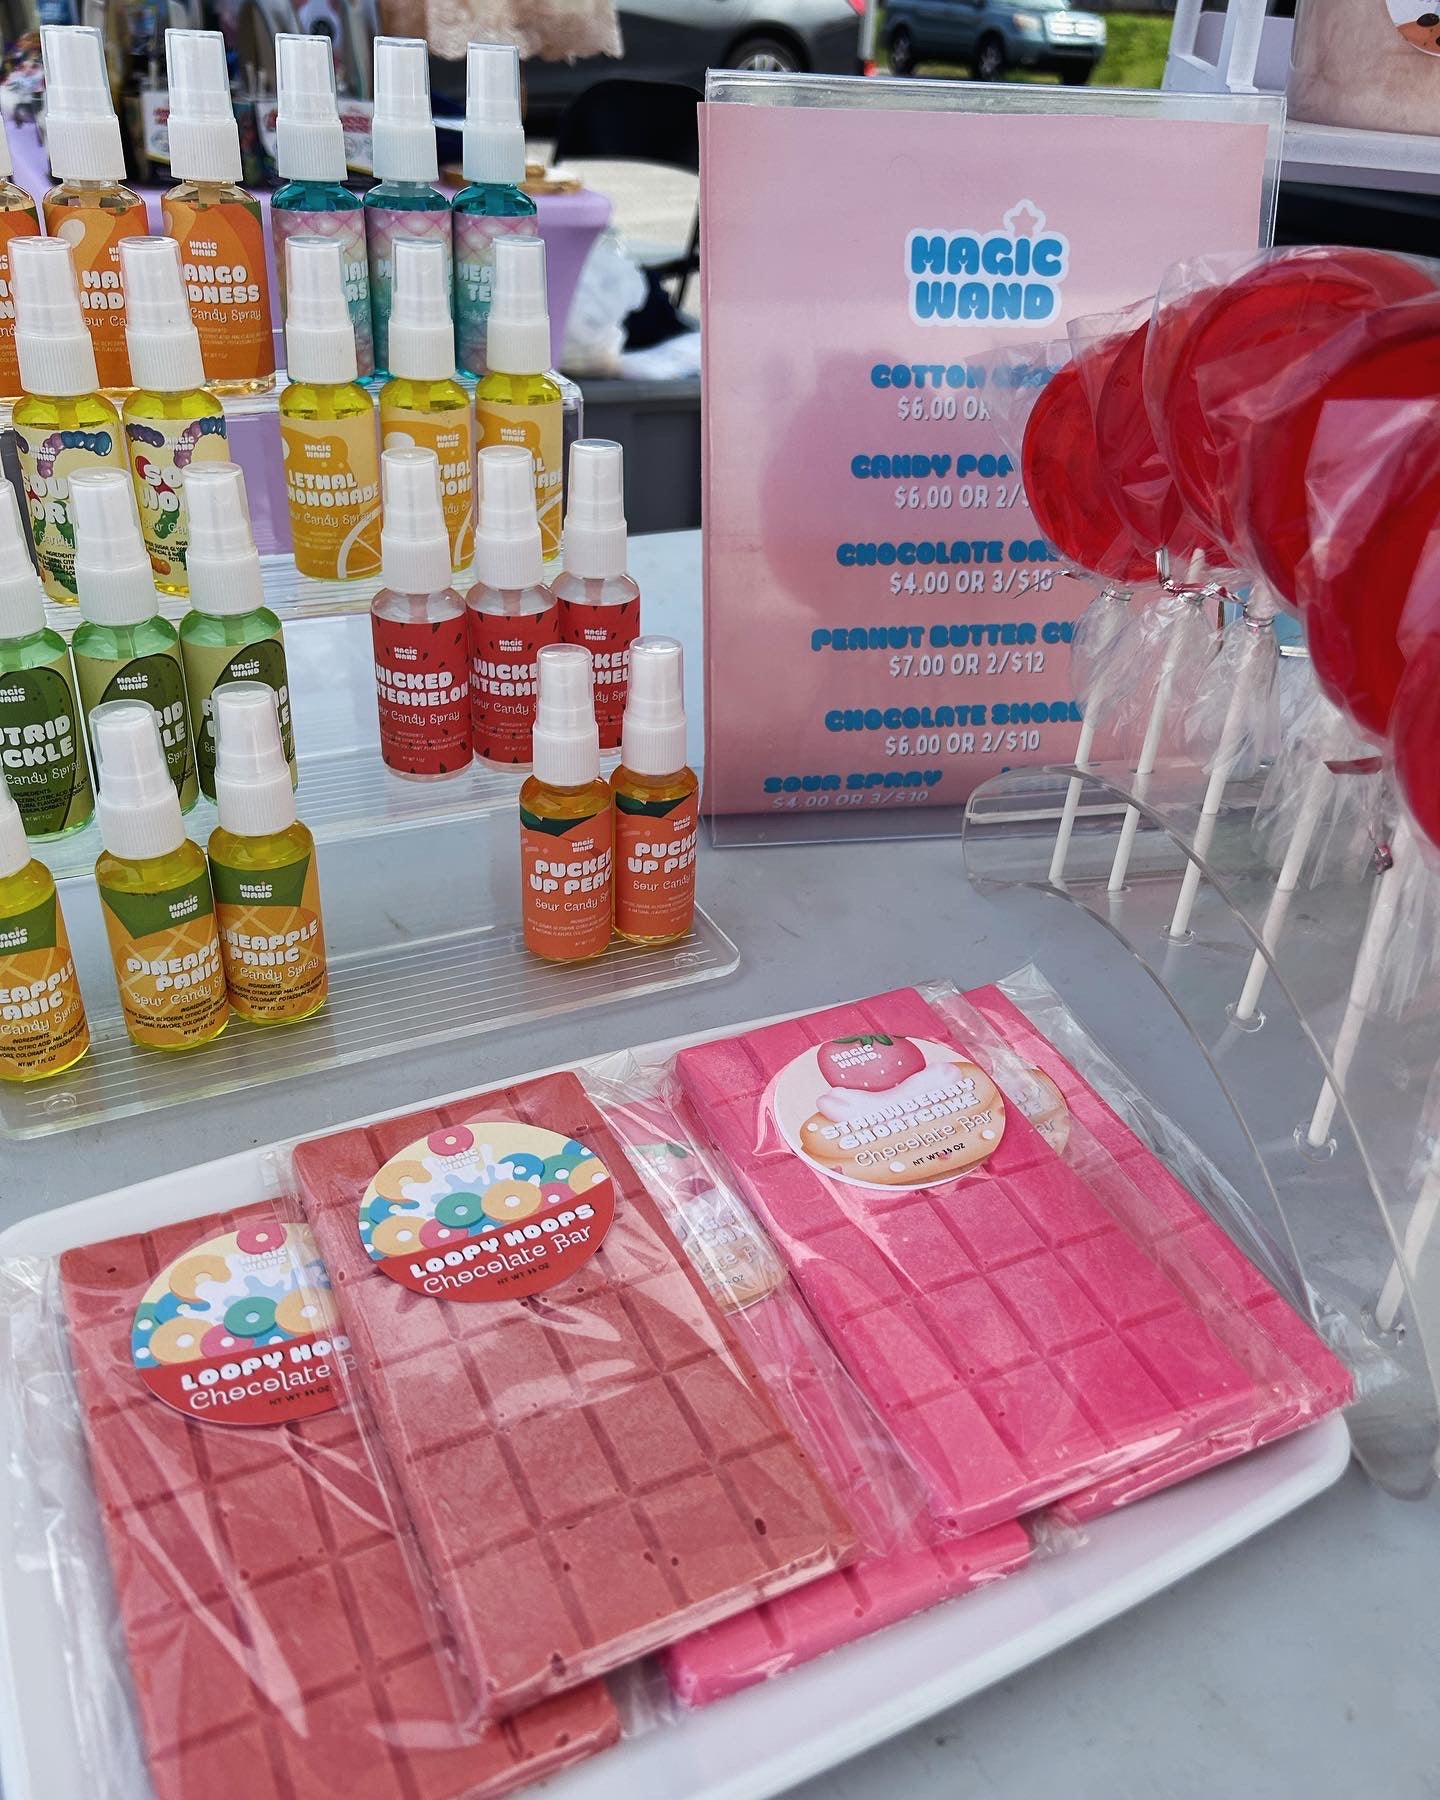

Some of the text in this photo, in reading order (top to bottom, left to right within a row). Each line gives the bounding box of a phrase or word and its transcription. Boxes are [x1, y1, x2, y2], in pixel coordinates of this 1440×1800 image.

[189, 240, 217, 250] MAGIC
[191, 249, 217, 257] WAND
[911, 235, 1063, 277] MAGIC
[183, 263, 247, 284] ANGO
[187, 284, 260, 304] DNESS
[915, 282, 1055, 320] WAND
[85, 316, 105, 328] our
[190, 307, 262, 324] Candy Spray
[870, 364, 986, 389] COTTON
[898, 396, 957, 421] $6.00
[851, 454, 952, 479] CANDY
[895, 484, 991, 509] $6.00 OR
[304, 512, 340, 528] Candy
[836, 538, 1058, 567] CHOCOLATE OR
[890, 569, 1054, 596] $4.00 OR 3/$10
[811, 621, 1075, 651] PEANUT BUTTER CU
[230, 660, 260, 671] MAGIC
[232, 668, 260, 678] WAND
[375, 662, 453, 690] WICKED
[473, 657, 538, 681] WICKE
[889, 651, 1045, 679] $7.00 OR 2/$12
[116, 674, 149, 684] MAGIC
[118, 682, 149, 691] WAND
[391, 710, 460, 727] Candy Spray
[493, 702, 530, 716] Candy
[824, 704, 987, 732] CHOCOLATE
[0, 714, 71, 746] TRID
[0, 735, 74, 768] CKLE
[885, 729, 1041, 757] $6.00 OR 2/$10
[4, 771, 48, 786] Candy
[763, 769, 944, 794] SOUR SPRAY
[773, 795, 830, 809] $4.00
[836, 793, 864, 806] OR
[627, 857, 659, 875] UP
[240, 882, 273, 892] MAGIC
[241, 891, 273, 899] WAND
[529, 873, 559, 894] UP
[633, 880, 659, 892] Sour
[168, 894, 199, 913] MAGIC
[171, 903, 198, 919] WAND
[535, 898, 560, 912] Sour
[564, 897, 598, 913] Candy
[126, 937, 220, 976] PINEAPP
[230, 947, 300, 966] PANIC
[0, 958, 75, 1004] EAPPLE
[156, 955, 220, 992] PANIC
[240, 957, 319, 982] Candy Spray
[0, 991, 64, 1021] ANIC
[132, 985, 212, 1007] Sour Candy
[0, 1020, 50, 1036] Candy
[830, 1043, 875, 1063] MAGIC
[837, 1051, 879, 1070] WAND
[821, 1078, 977, 1140] STRAWBERRY
[838, 1093, 980, 1150] SHORTCAKE
[856, 1110, 993, 1167] Chocolate Bar
[912, 1142, 966, 1166] NT WT OZ
[410, 1203, 596, 1279] LOOPY HOOPS
[423, 1226, 591, 1294] Chocolate Bar
[181, 1335, 351, 1391] LOOPY HOO
[189, 1363, 331, 1410] Chocolate
